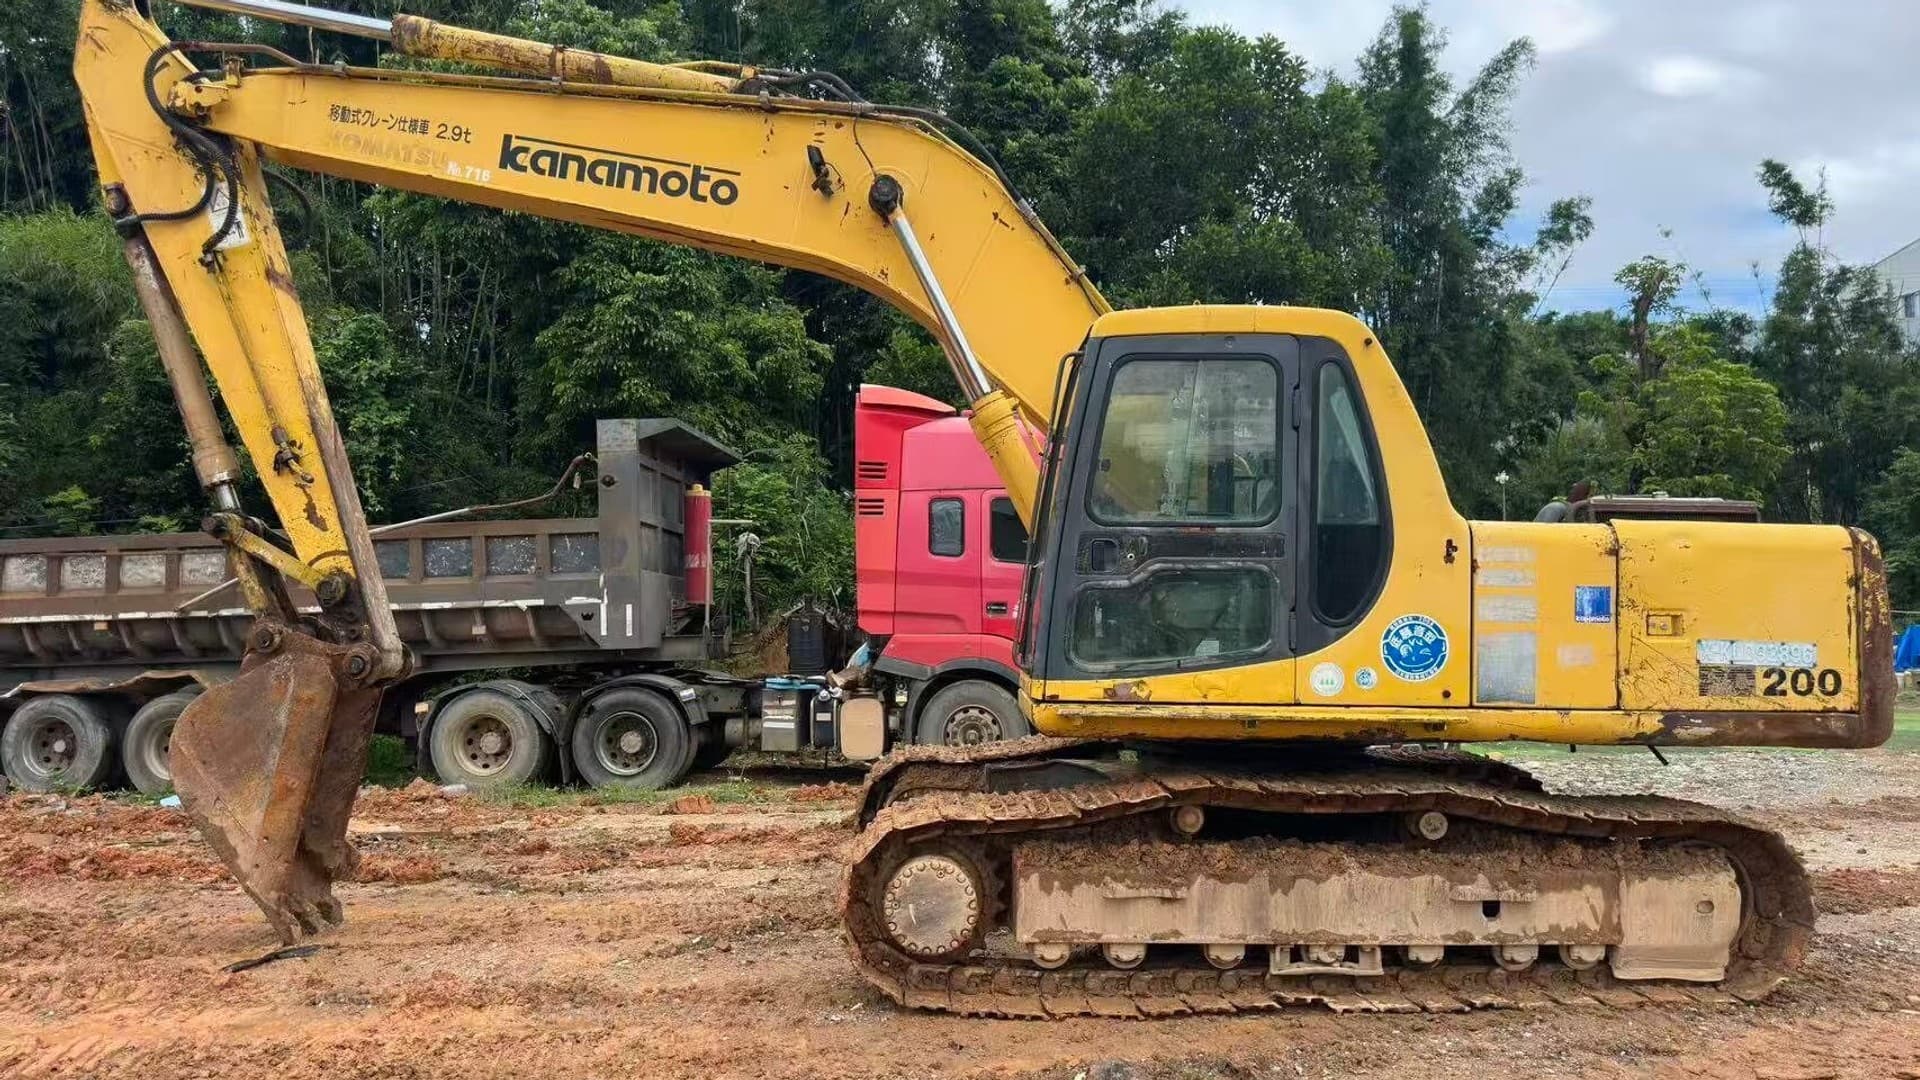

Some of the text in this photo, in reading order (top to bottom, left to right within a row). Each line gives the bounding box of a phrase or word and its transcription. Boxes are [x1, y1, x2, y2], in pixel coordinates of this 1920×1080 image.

[328, 103, 472, 144] 移動式クレーン仕様車 2.9t
[499, 134, 740, 205] kanamoto
[1763, 667, 1842, 697] 200
